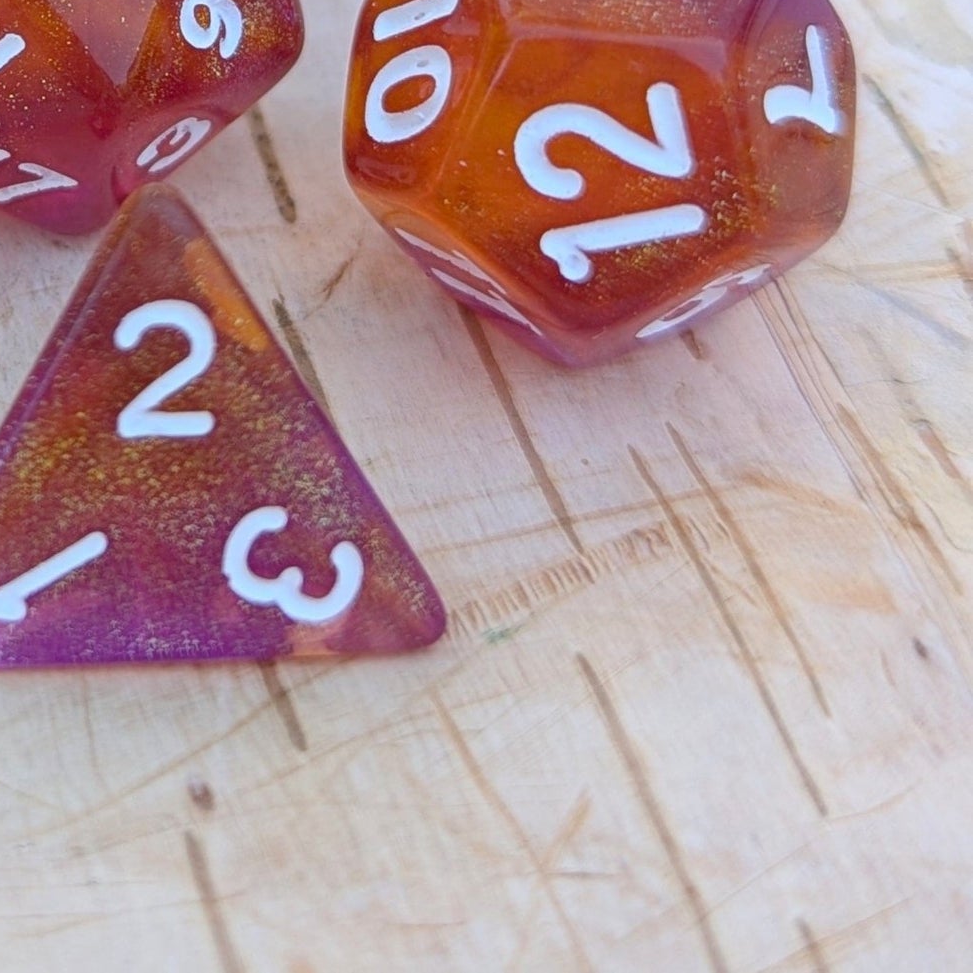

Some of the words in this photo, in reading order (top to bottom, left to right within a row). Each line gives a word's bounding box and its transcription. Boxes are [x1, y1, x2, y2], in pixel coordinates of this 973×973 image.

[513, 82, 709, 283] 12
[114, 299, 216, 438] 2
[222, 506, 364, 624] 3
